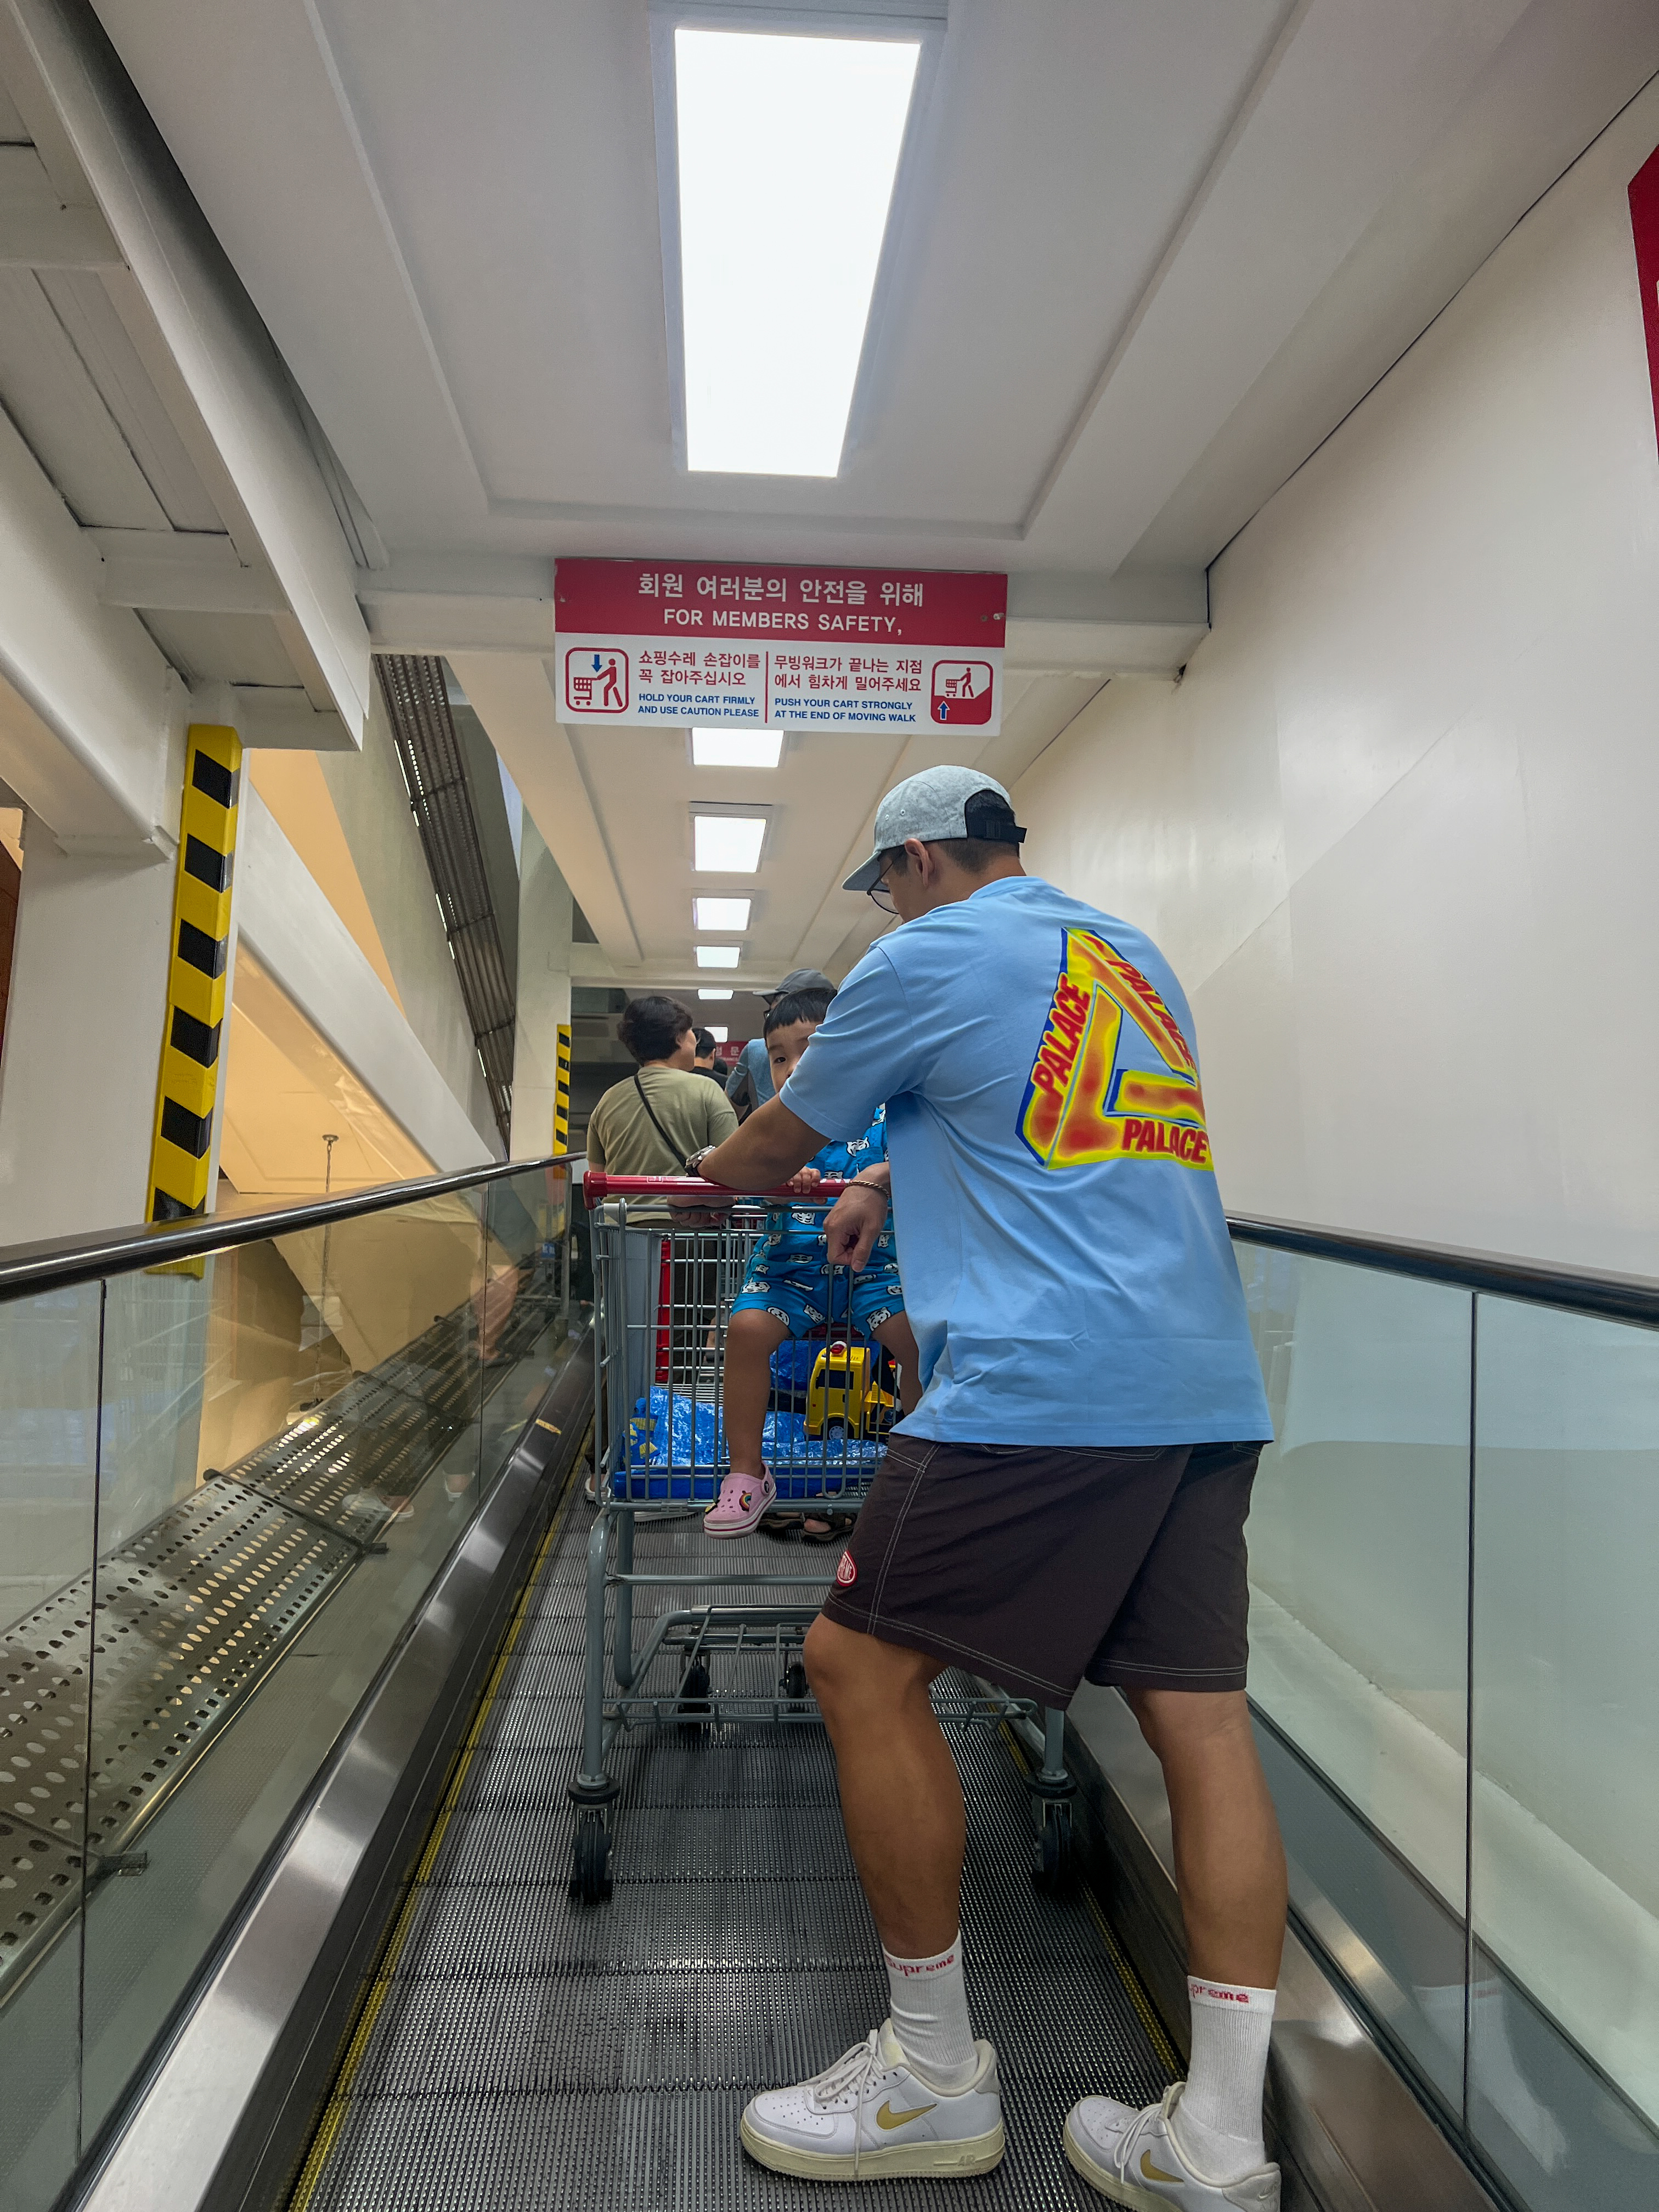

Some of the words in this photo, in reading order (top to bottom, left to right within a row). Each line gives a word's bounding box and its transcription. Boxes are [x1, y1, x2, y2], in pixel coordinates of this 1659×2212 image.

[639, 573, 683, 597] 회원
[697, 575, 786, 602] 여러분의
[800, 579, 868, 605] 안전을
[880, 582, 923, 607] 위해
[664, 608, 703, 625] FOR
[713, 611, 809, 630] MEMBERS
[818, 614, 902, 635] SAFETY,
[639, 650, 696, 666] 쇼핑수레
[703, 652, 760, 668] 손잡이를
[774, 655, 842, 671] 무빙워크가
[849, 657, 889, 673] 끝나는
[896, 659, 922, 674] 지점
[639, 669, 653, 683] 꼭
[661, 669, 746, 686] 잡아주십시오
[775, 674, 800, 688] 에서
[809, 674, 848, 690] 힘차게
[855, 676, 922, 692] 밀어주세요
[667, 694, 692, 702] YOUR
[695, 695, 720, 703] CART
[723, 696, 755, 704] FIRMLY
[775, 698, 801, 706] PUSH
[804, 699, 830, 708] YOUR
[833, 700, 859, 708] CART
[861, 701, 912, 710] STRONGLY
[681, 707, 721, 715] CAUTION
[724, 708, 759, 716] PLEASE
[789, 710, 808, 719] THE
[810, 711, 830, 719] END
[848, 713, 885, 721] MOVING
[889, 714, 916, 722] WALK
[1032, 973, 1091, 1093] PALACE
[1122, 1119, 1207, 1164] PALACE
